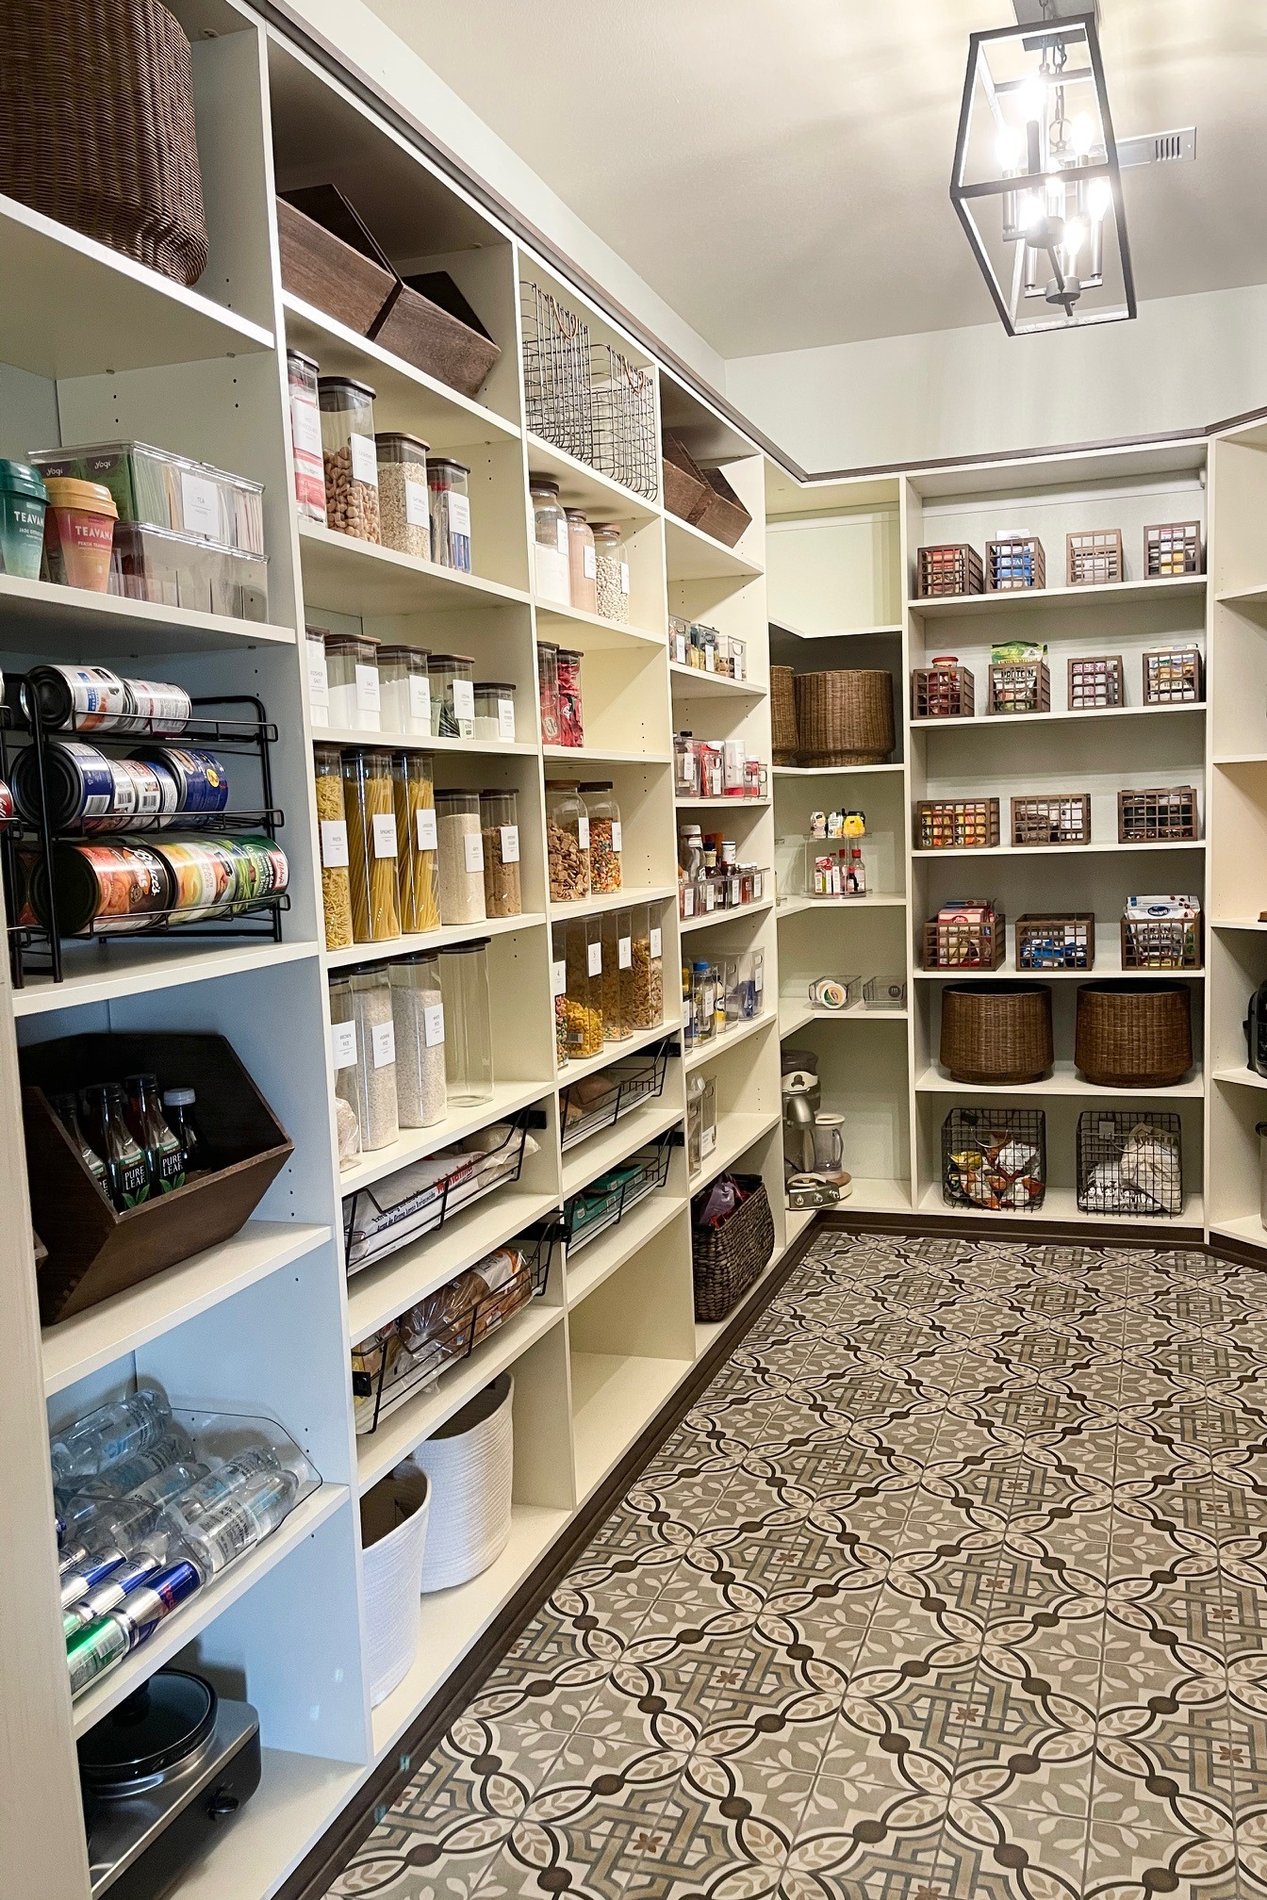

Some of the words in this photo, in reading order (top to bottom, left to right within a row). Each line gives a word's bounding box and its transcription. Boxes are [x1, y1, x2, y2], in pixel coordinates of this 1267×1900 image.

[46, 467, 63, 476] yogi
[94, 460, 111, 469] yogi
[162, 1151, 182, 1168] PURE
[124, 1165, 145, 1183] PURE
[163, 1162, 184, 1177] LEAF
[125, 1175, 146, 1191] LEAF
